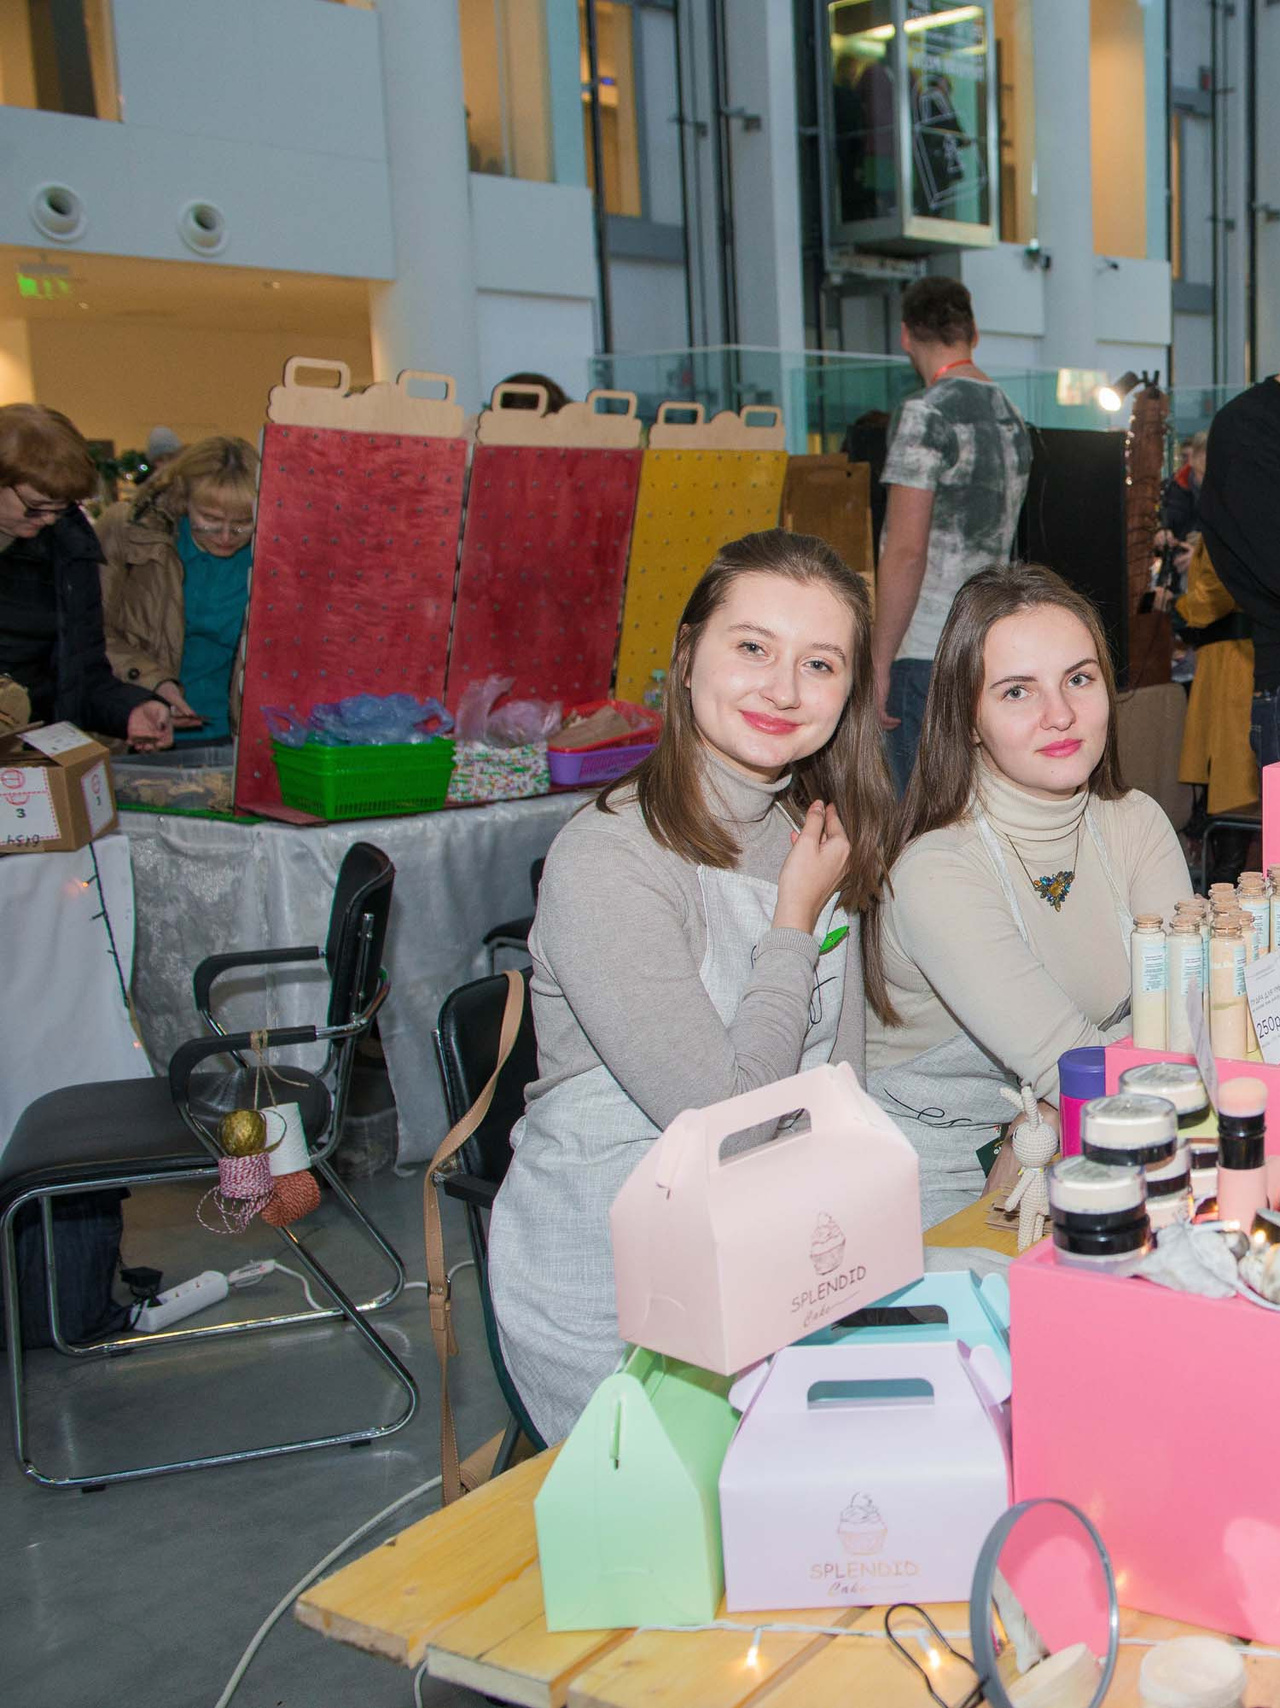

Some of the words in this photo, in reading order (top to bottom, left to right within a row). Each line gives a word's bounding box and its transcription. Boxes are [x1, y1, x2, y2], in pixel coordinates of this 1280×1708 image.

[16, 808, 26, 818] 3
[791, 1265, 866, 1313] SPLENDID
[810, 1560, 920, 1579] SPLENDID
